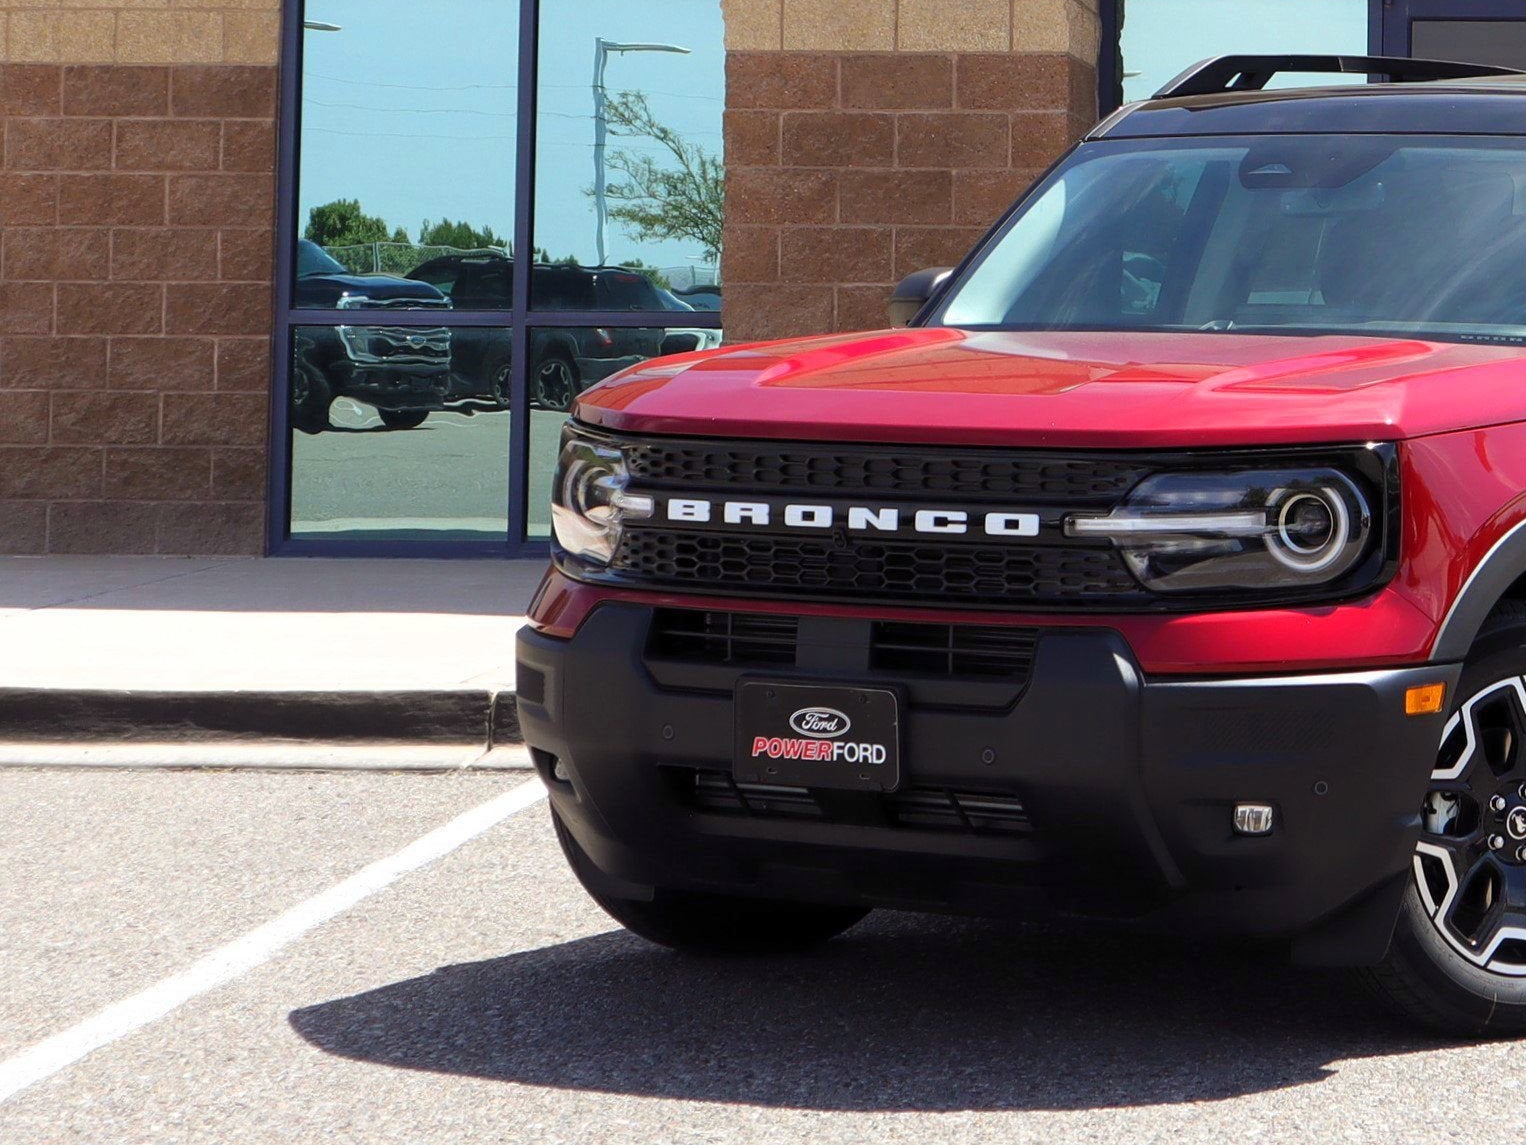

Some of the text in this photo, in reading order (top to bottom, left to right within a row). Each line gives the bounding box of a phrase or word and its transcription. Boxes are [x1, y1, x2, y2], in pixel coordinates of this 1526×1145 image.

[667, 498, 1040, 537] BRONCO
[801, 712, 838, 732] Ford
[751, 736, 887, 764] POWERFORD
